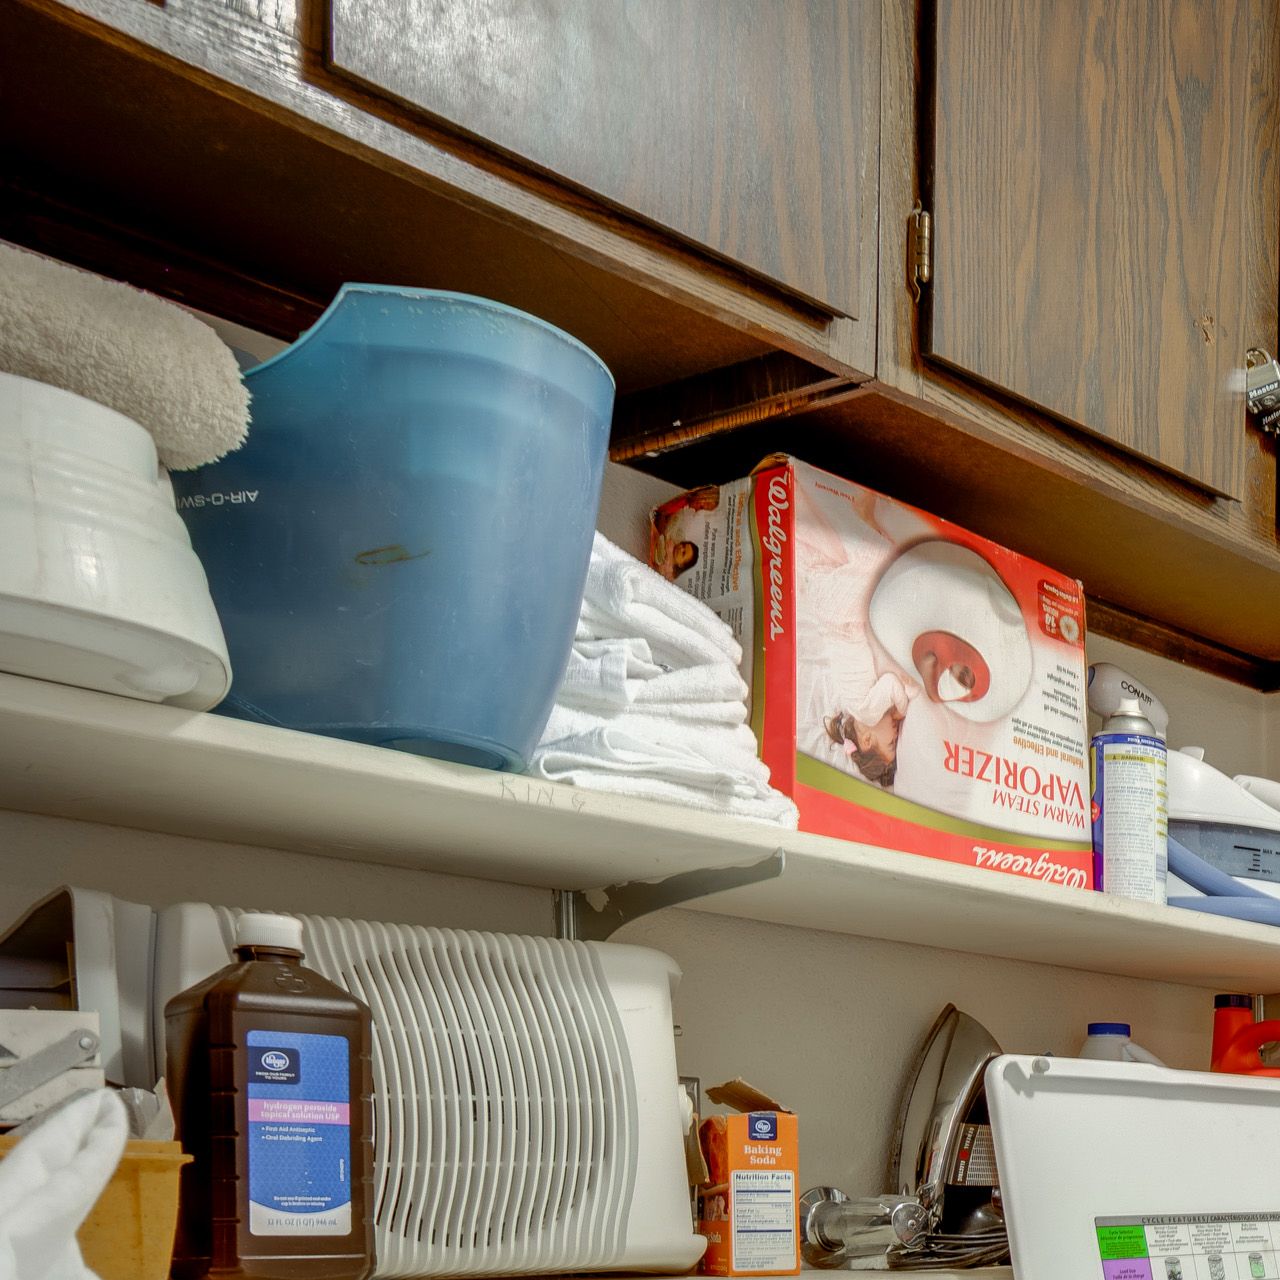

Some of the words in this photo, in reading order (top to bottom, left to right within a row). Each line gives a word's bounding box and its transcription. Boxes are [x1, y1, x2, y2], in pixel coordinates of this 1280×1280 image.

[763, 471, 790, 641] Walgreens
[1120, 680, 1153, 705] CONAIR
[1012, 735, 1045, 757] Effective
[1045, 746, 1058, 759] and
[1059, 752, 1084, 769] Natural
[943, 740, 1085, 810] VAPORIZER
[992, 789, 1040, 817] STEAM
[1043, 803, 1085, 829] WARM
[972, 845, 1088, 889] Walgreens
[263, 1101, 302, 1113] hydrogen
[304, 1103, 337, 1113] peroxide
[261, 1110, 290, 1121] topical
[291, 1111, 324, 1120] solution
[744, 1145, 782, 1157] Baking
[750, 1155, 776, 1165] Soda
[736, 1173, 769, 1181] Nutrition
[771, 1173, 791, 1181] Facts
[285, 1218, 295, 1226] OZ
[1141, 1216, 1165, 1224] CYCLE
